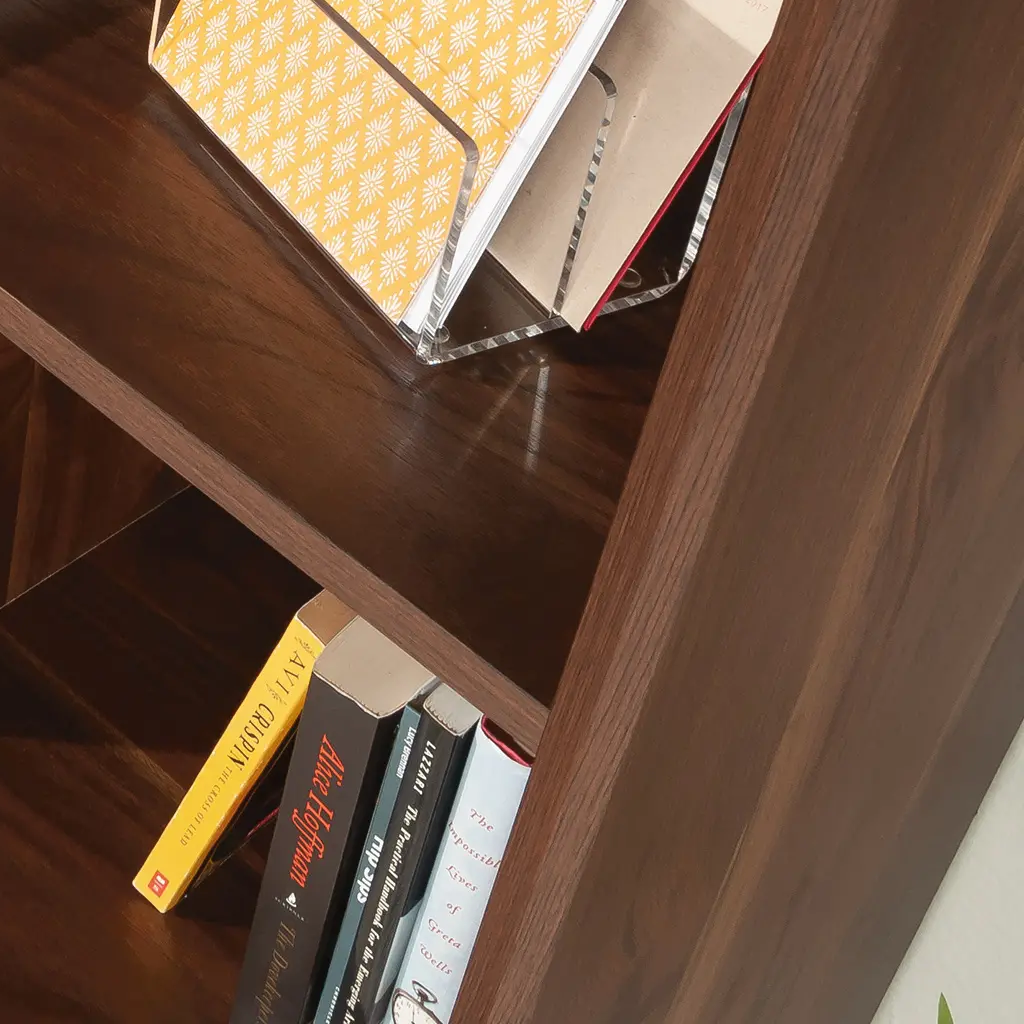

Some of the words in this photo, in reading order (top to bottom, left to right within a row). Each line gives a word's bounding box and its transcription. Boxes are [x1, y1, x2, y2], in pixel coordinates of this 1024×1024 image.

[275, 650, 307, 695] AVI
[226, 703, 276, 772] CRISPIN
[217, 765, 234, 784] THE
[311, 733, 346, 797] Alice
[413, 740, 437, 796] LAZZARI
[201, 782, 222, 814] CROSS
[404, 804, 420, 827] The
[470, 808, 494, 832] The
[179, 822, 198, 847] LEAD
[290, 788, 335, 888] Hoffman
[388, 826, 412, 879] Practical
[446, 865, 479, 893] Lives
[373, 872, 398, 928] Handbook
[446, 902, 462, 915] of
[366, 926, 382, 946] for
[428, 918, 462, 949] Greta
[360, 945, 375, 966] the
[419, 943, 453, 976] Wells
[345, 964, 370, 1011] Emerging
